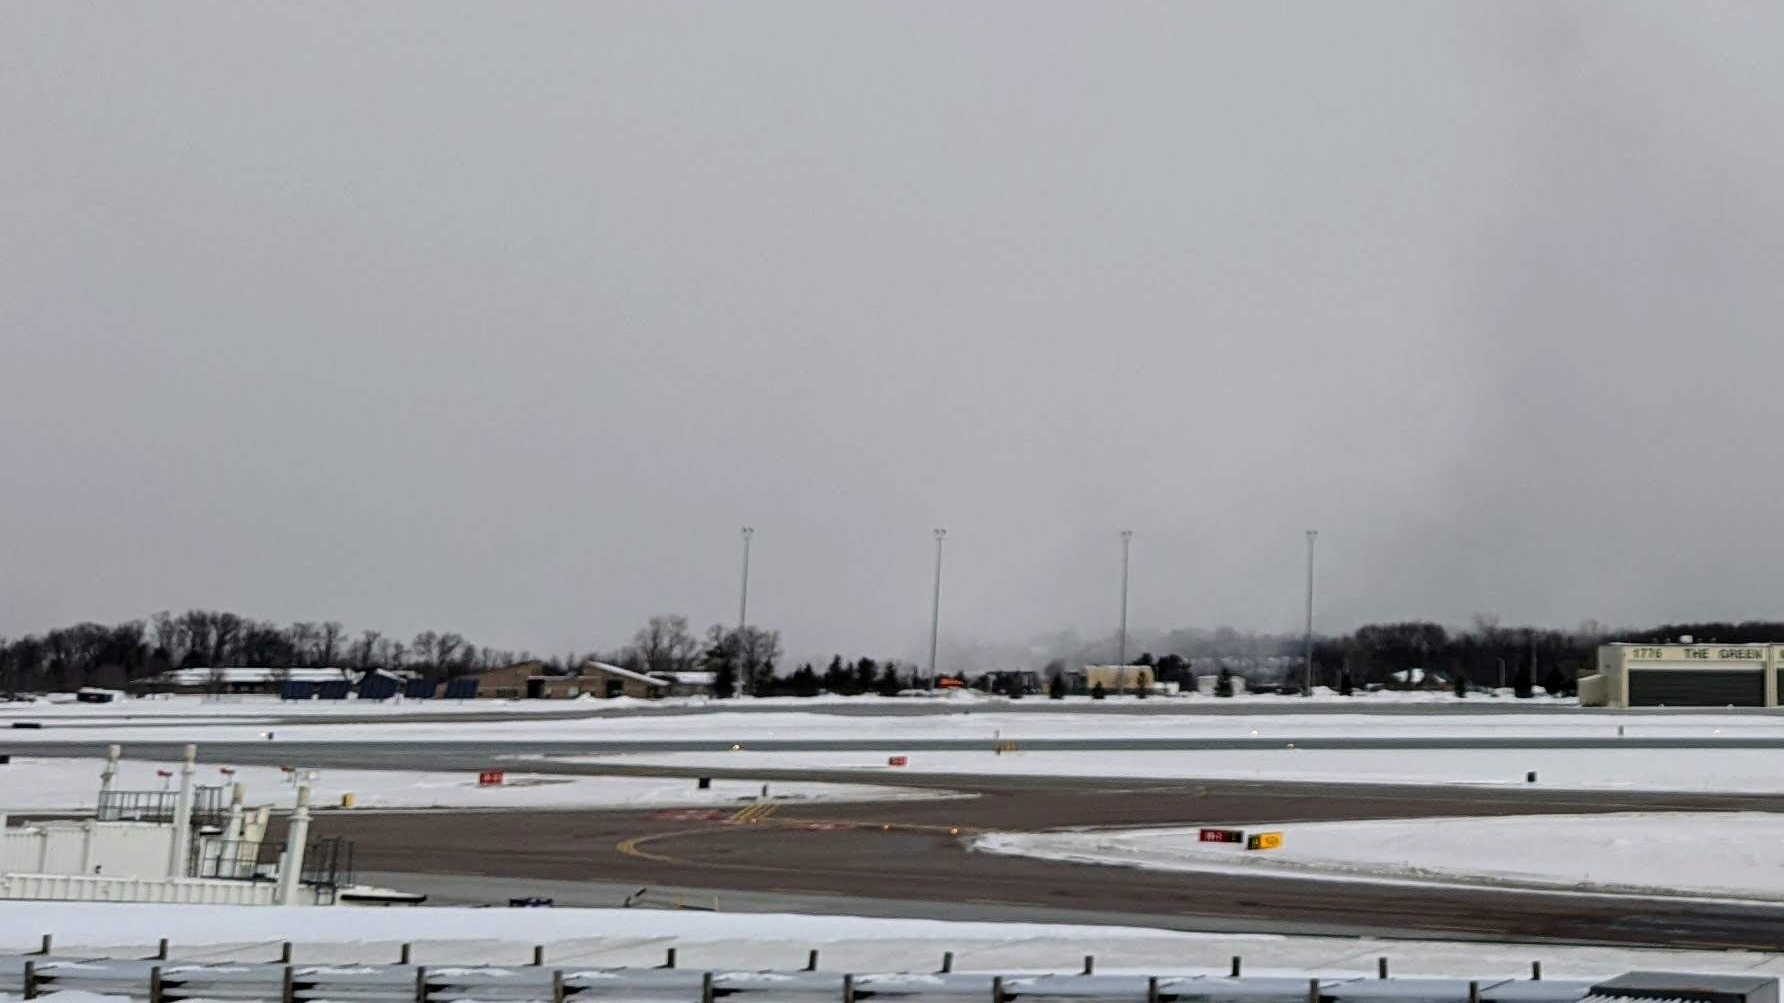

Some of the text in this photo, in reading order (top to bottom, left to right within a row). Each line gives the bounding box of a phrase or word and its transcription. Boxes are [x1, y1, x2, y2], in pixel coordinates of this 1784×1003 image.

[1632, 647, 1662, 659] 1776
[1683, 647, 1709, 659] THE
[1719, 648, 1762, 659] GREEN
